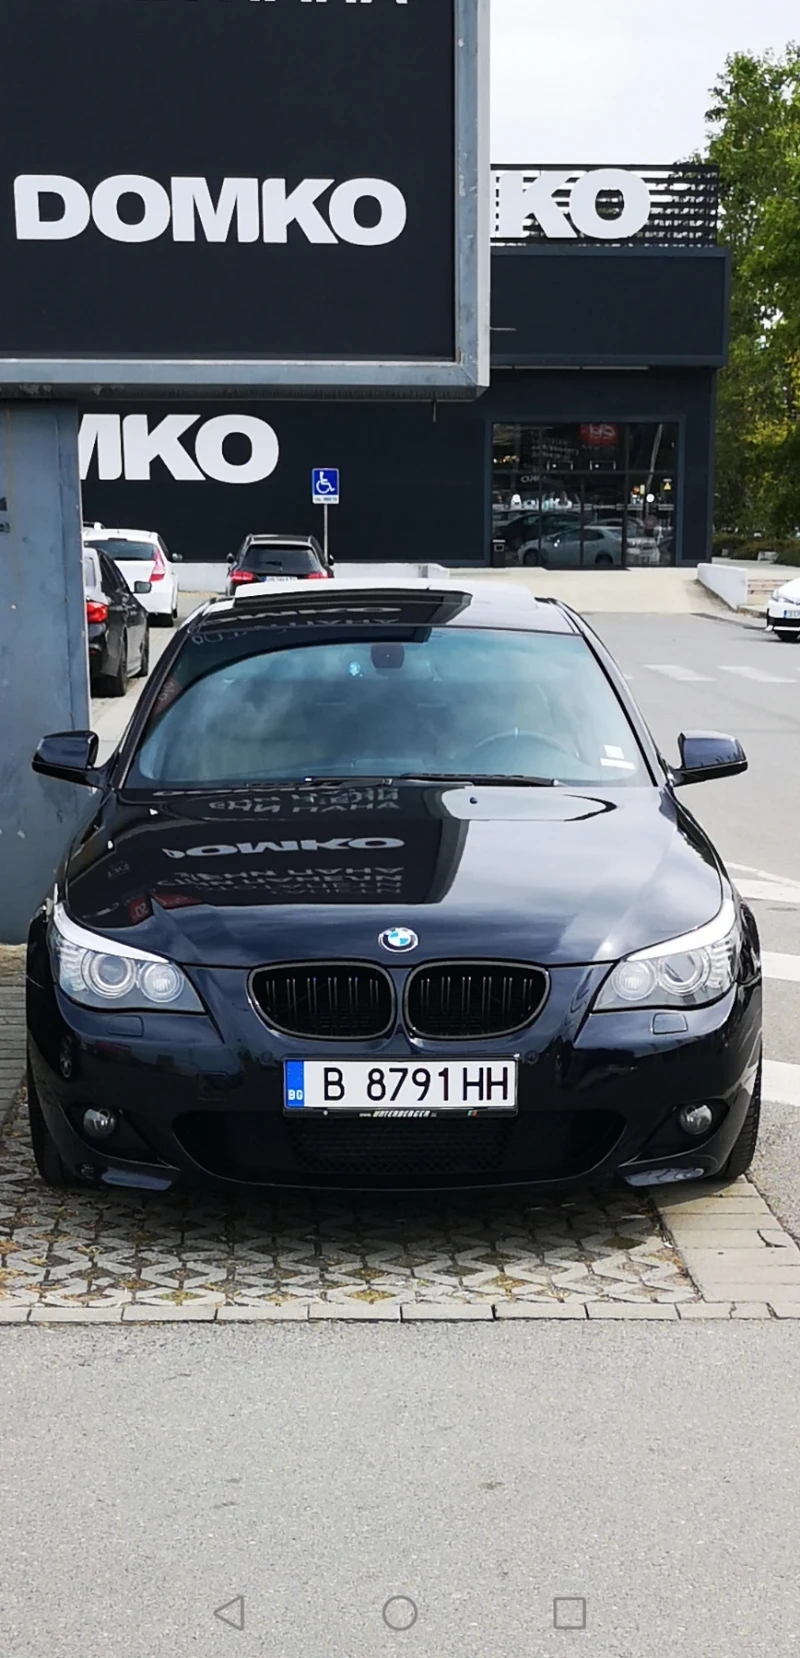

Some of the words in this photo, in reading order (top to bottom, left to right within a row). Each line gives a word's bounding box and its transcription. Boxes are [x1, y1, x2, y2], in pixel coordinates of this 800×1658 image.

[14, 174, 407, 246] DOMKO
[490, 168, 651, 239] KO
[288, 1089, 303, 1100] BG
[324, 1067, 345, 1101] B
